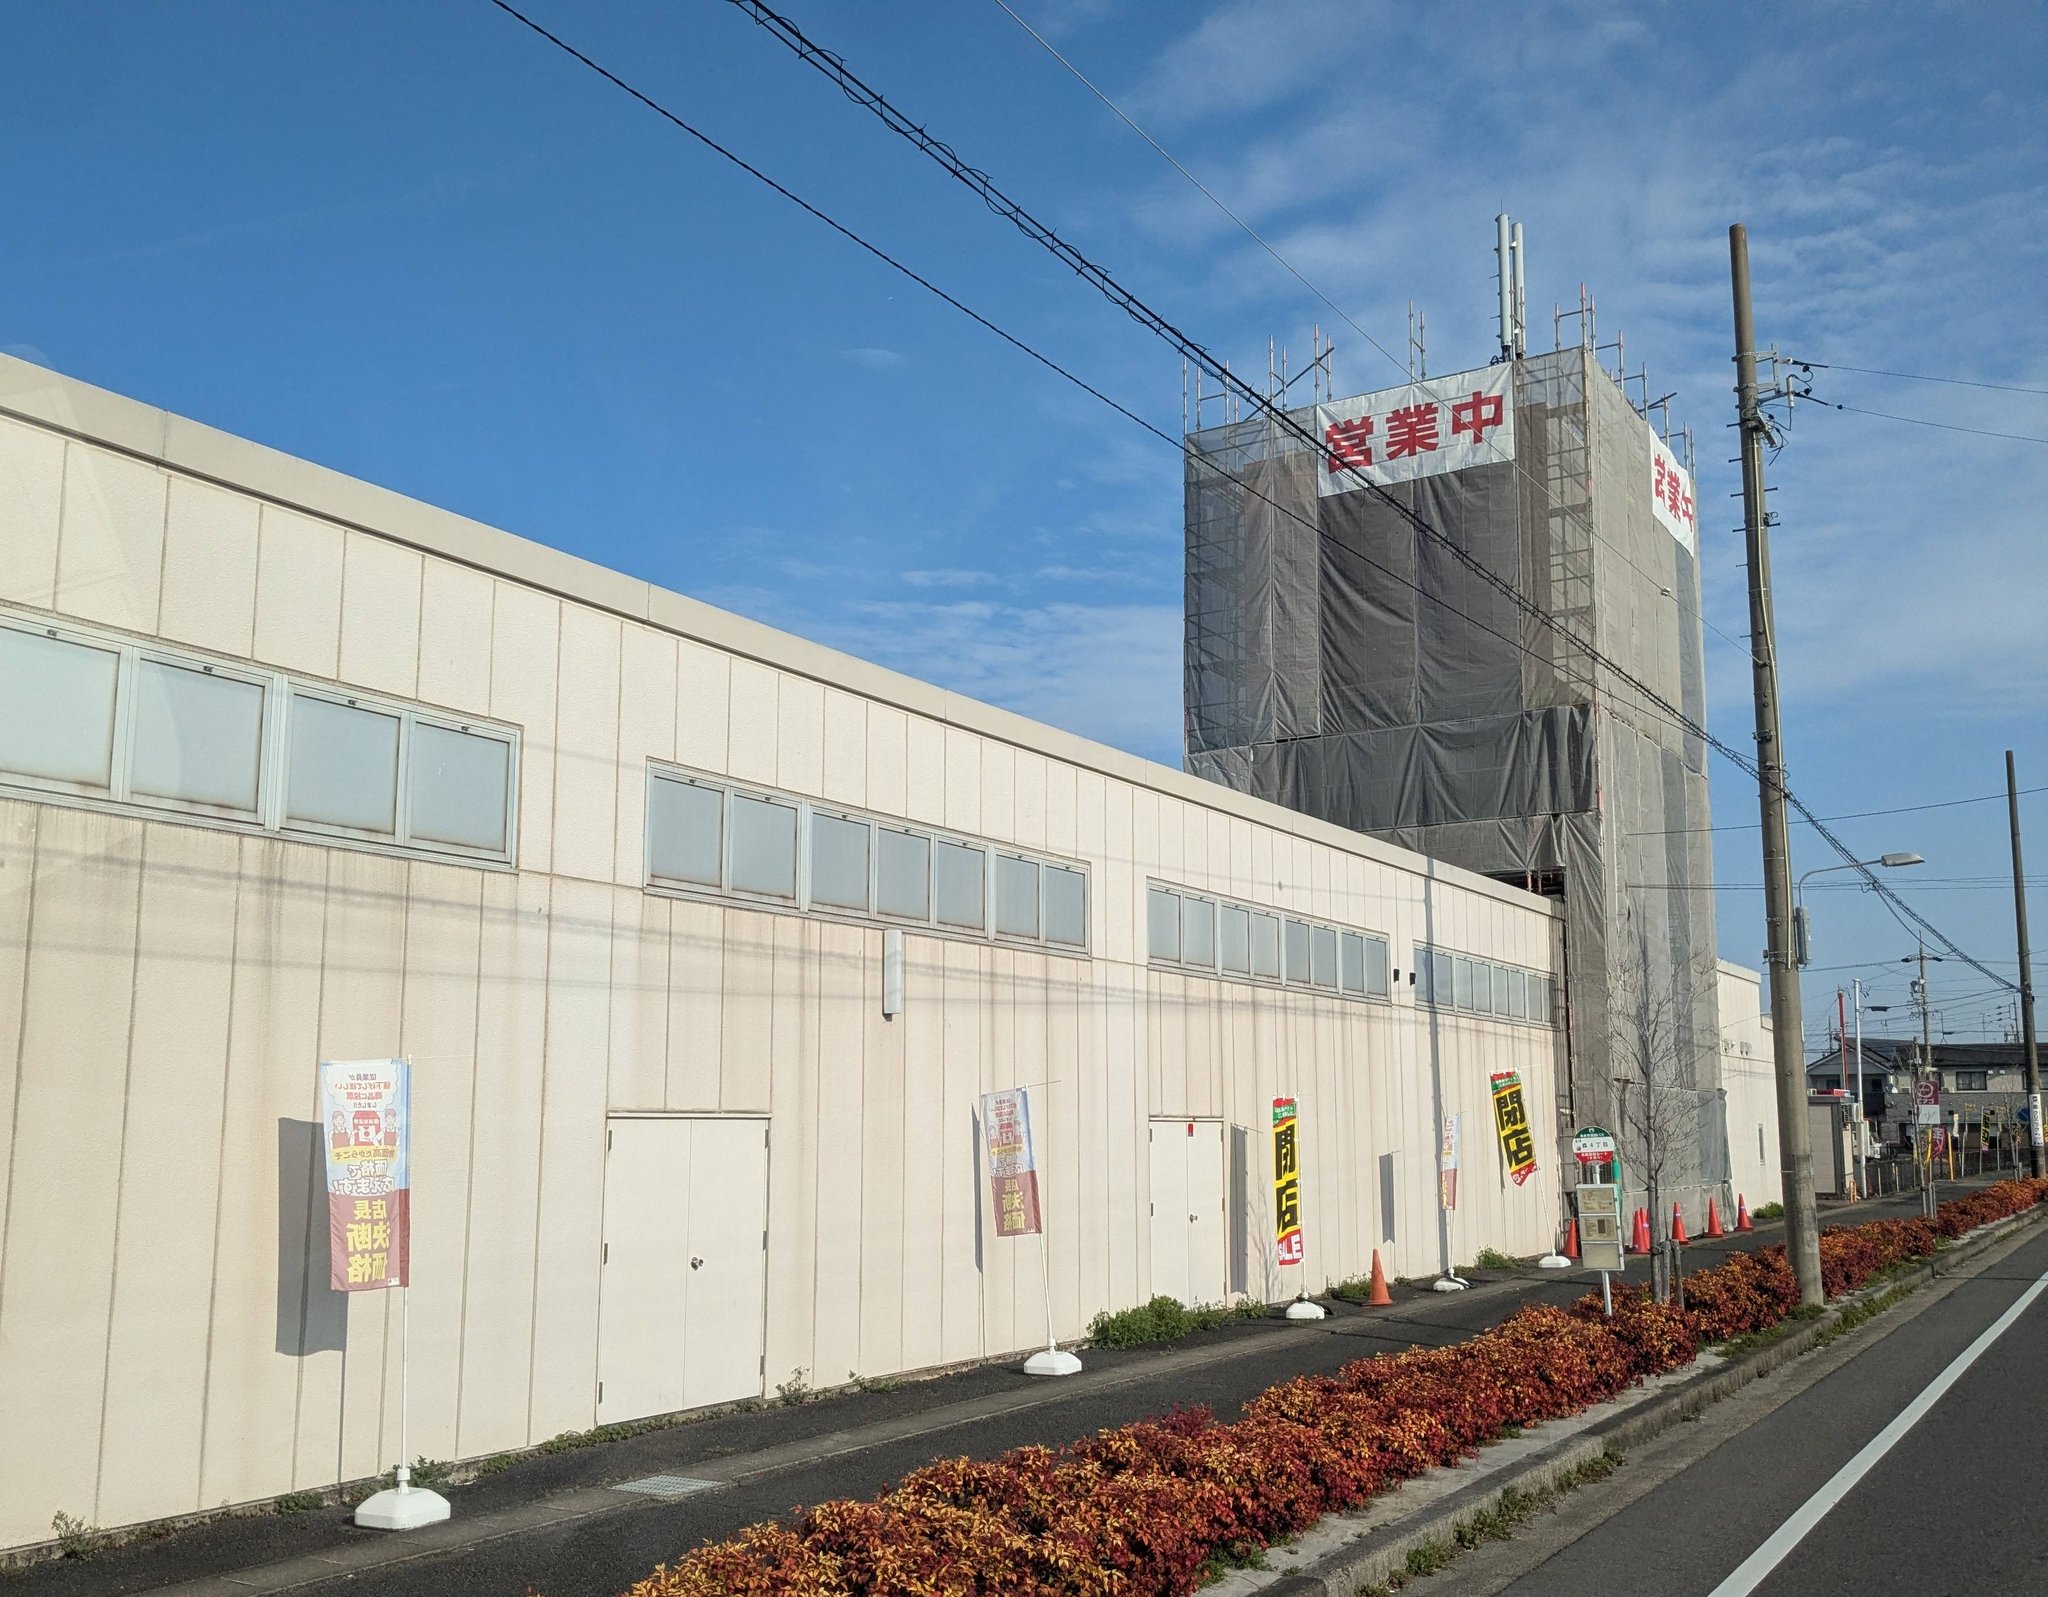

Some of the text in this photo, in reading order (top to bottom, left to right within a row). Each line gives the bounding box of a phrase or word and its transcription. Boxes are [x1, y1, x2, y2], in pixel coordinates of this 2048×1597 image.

[1325, 390, 1504, 474] 営業中
[1496, 1089, 1533, 1170] 閉店
[1275, 1122, 1299, 1237] 閉店
